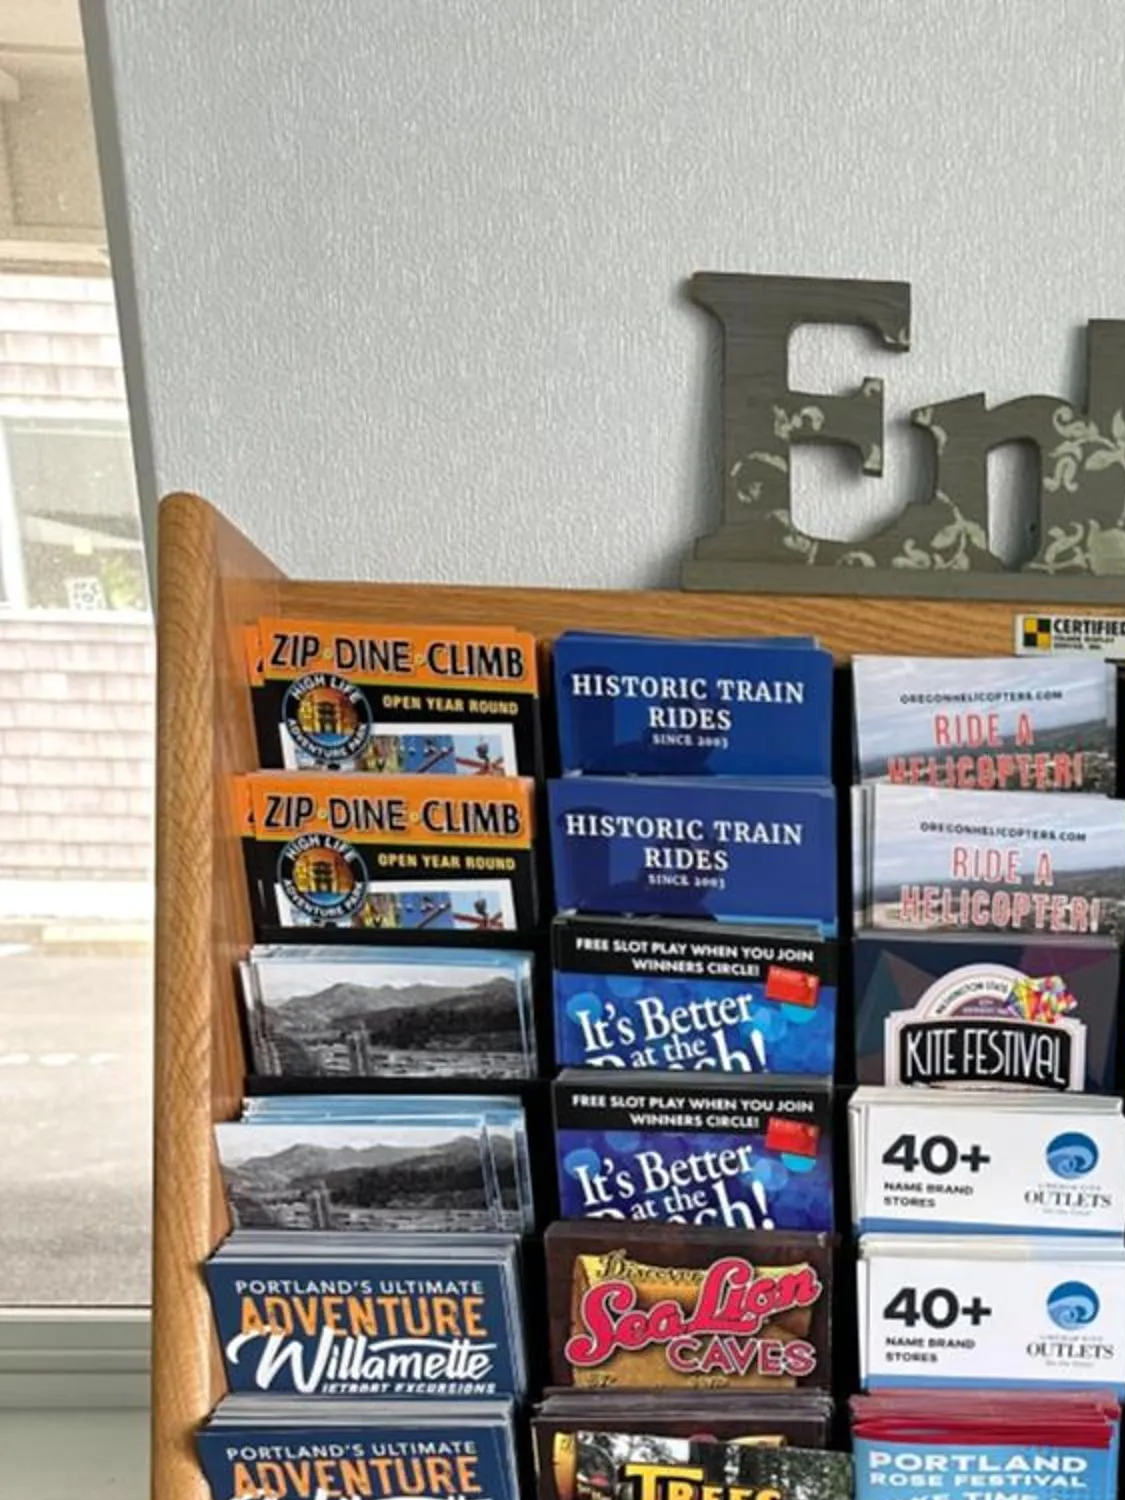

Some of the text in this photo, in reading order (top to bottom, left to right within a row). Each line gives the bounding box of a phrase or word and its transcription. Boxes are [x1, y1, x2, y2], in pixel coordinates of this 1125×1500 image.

[272, 634, 524, 678] ZIP DINE CLIMB
[572, 674, 805, 704] HISTORIC TRAIN
[900, 689, 1063, 704] OREGONHELICOPTERS.COM
[383, 695, 518, 716] OPEN YEAR ROUND
[649, 707, 731, 731] RIDES
[934, 711, 1034, 746] RIDE A
[901, 885, 1101, 934] HELICOPTER!
[576, 937, 814, 962] FREE SLOT PLAY WHEN YOU JOIN
[633, 957, 760, 976] WINNERS CIRCLE!
[577, 993, 754, 1054] It's Better
[632, 1050, 658, 1068] at
[663, 1033, 707, 1063] the
[907, 1029, 1065, 1084] KITE FESTIVAL
[882, 1134, 990, 1175] 40+
[883, 1196, 936, 1208] STORES
[884, 1182, 974, 1195] NAME BRAND
[1024, 1190, 1112, 1208] OUTLETS
[235, 1279, 483, 1296] PORTLAND'S ULTIMATE
[240, 1296, 488, 1338] ADVENTURE
[565, 1257, 822, 1366] Sea Lion
[227, 1325, 497, 1393] Willamette
[666, 1336, 816, 1375] CAVES
[868, 1451, 1088, 1473] PORTLAND
[869, 1474, 1086, 1490] ROSE FESTIVAL
